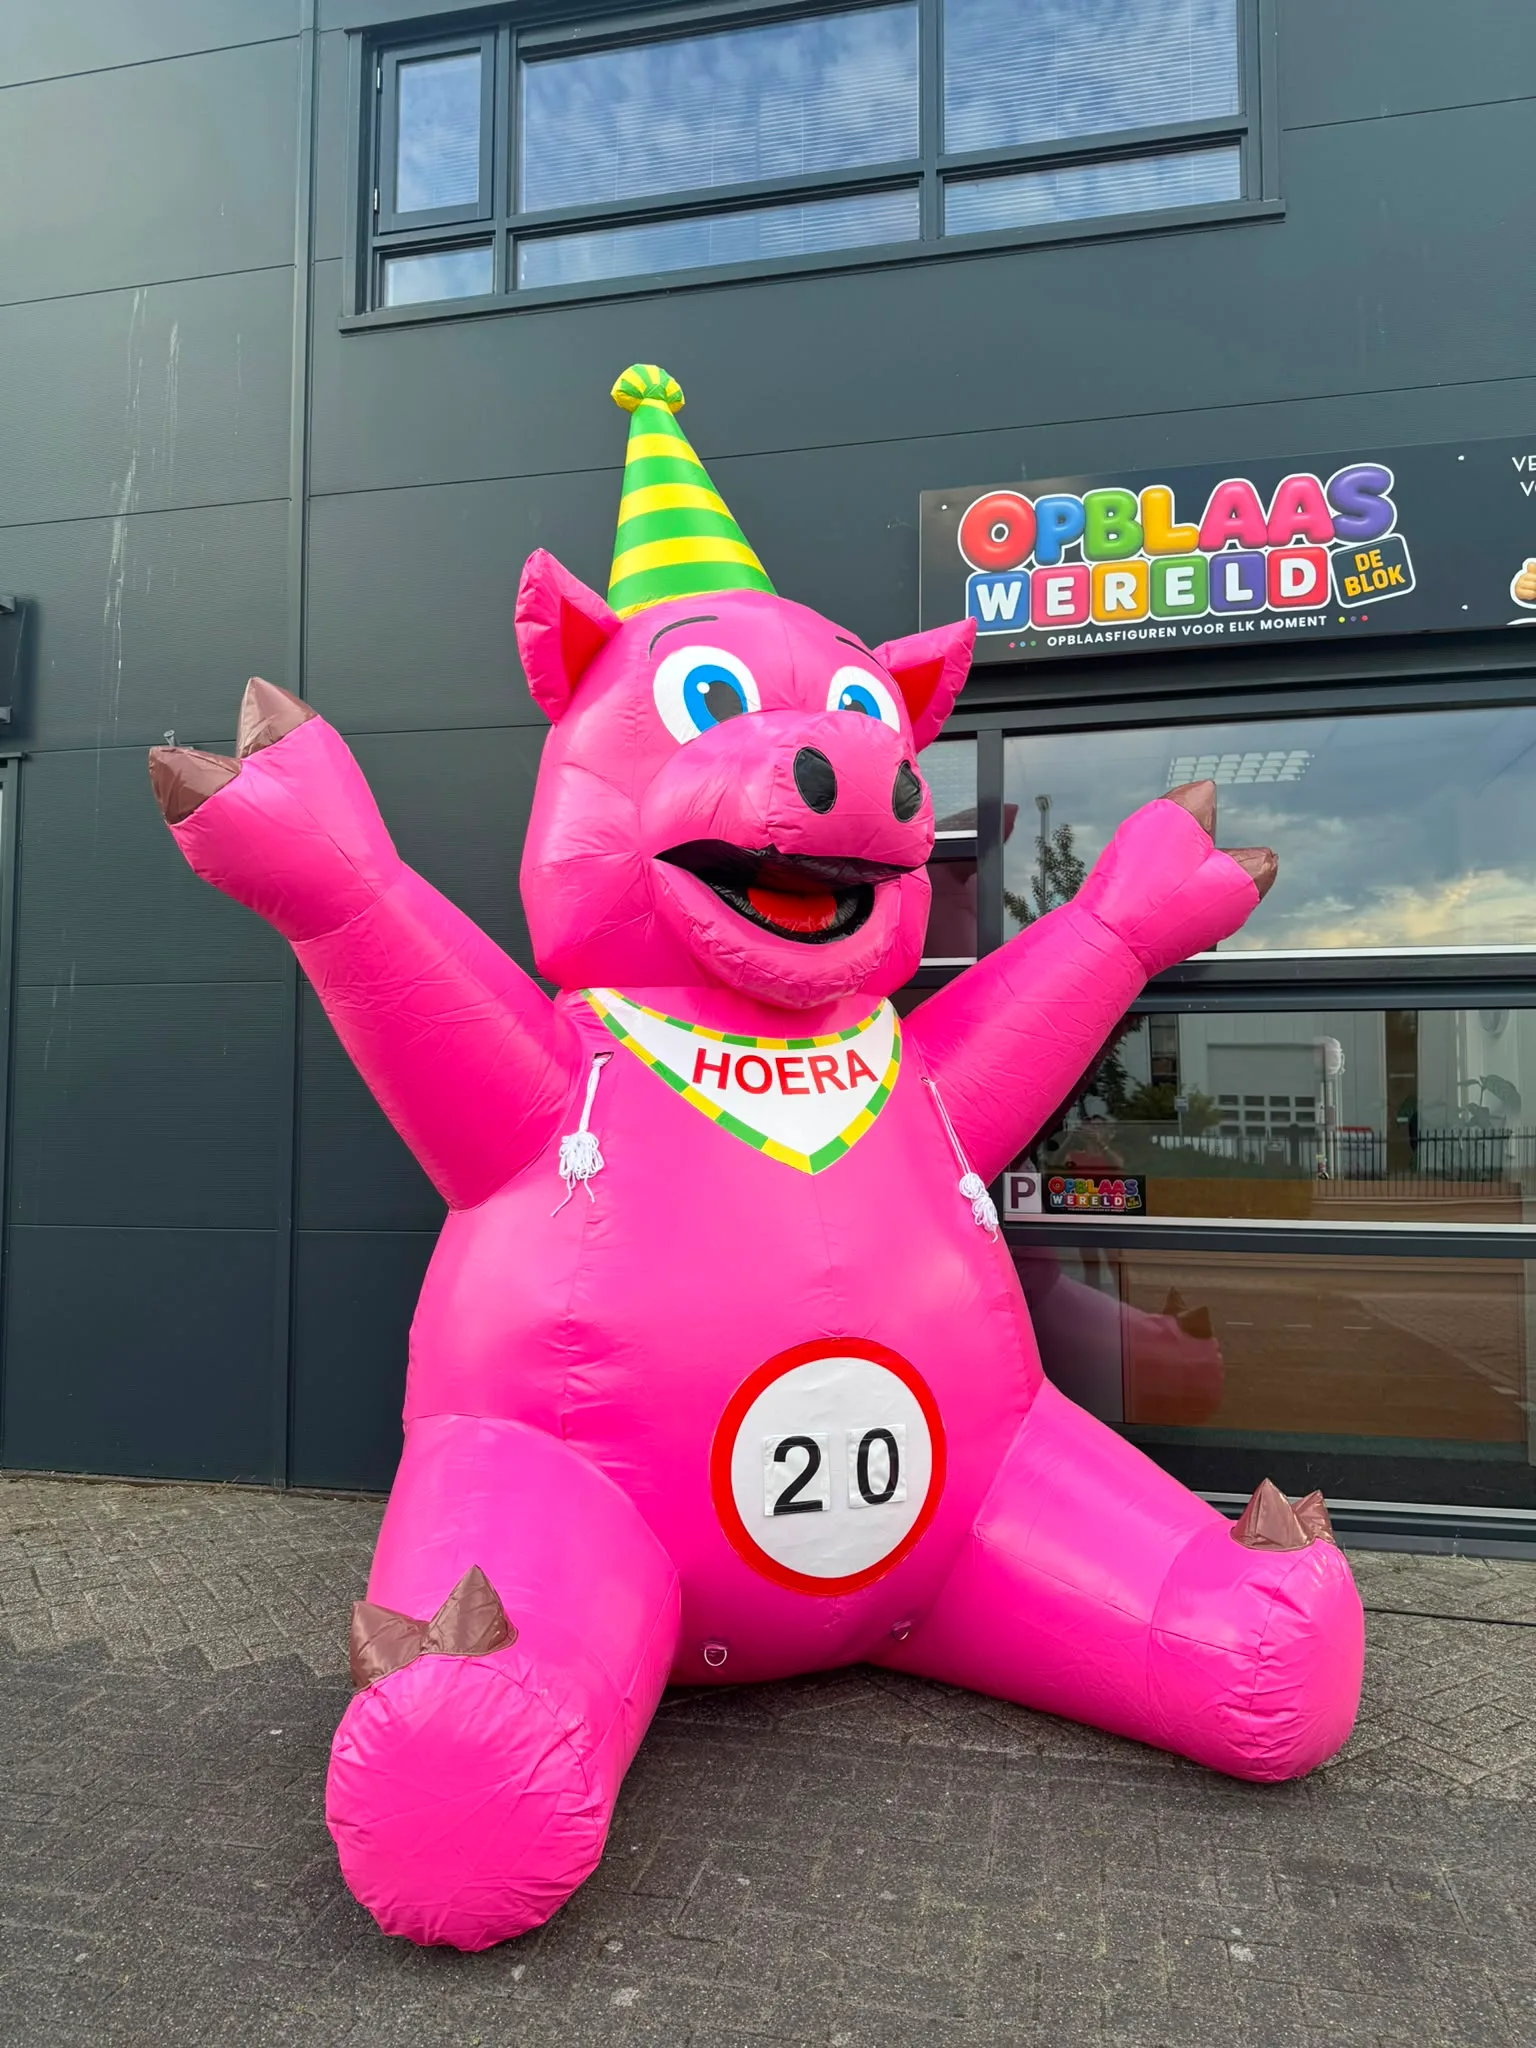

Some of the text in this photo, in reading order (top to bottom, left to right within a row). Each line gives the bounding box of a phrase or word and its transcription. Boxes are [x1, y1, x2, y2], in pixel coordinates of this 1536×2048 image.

[959, 462, 1397, 572] OPBLAAS
[1354, 549, 1384, 573] DE
[975, 557, 1318, 622] WERELD
[1344, 564, 1406, 597] BLOK
[1047, 615, 1328, 647] OPBLAASFIGUREN VOOR ELK MOMENT
[692, 1047, 878, 1095] HOERA
[1010, 1176, 1036, 1209] P
[1048, 1176, 1138, 1196] OPBLAAS
[1052, 1195, 1123, 1207] WERELD
